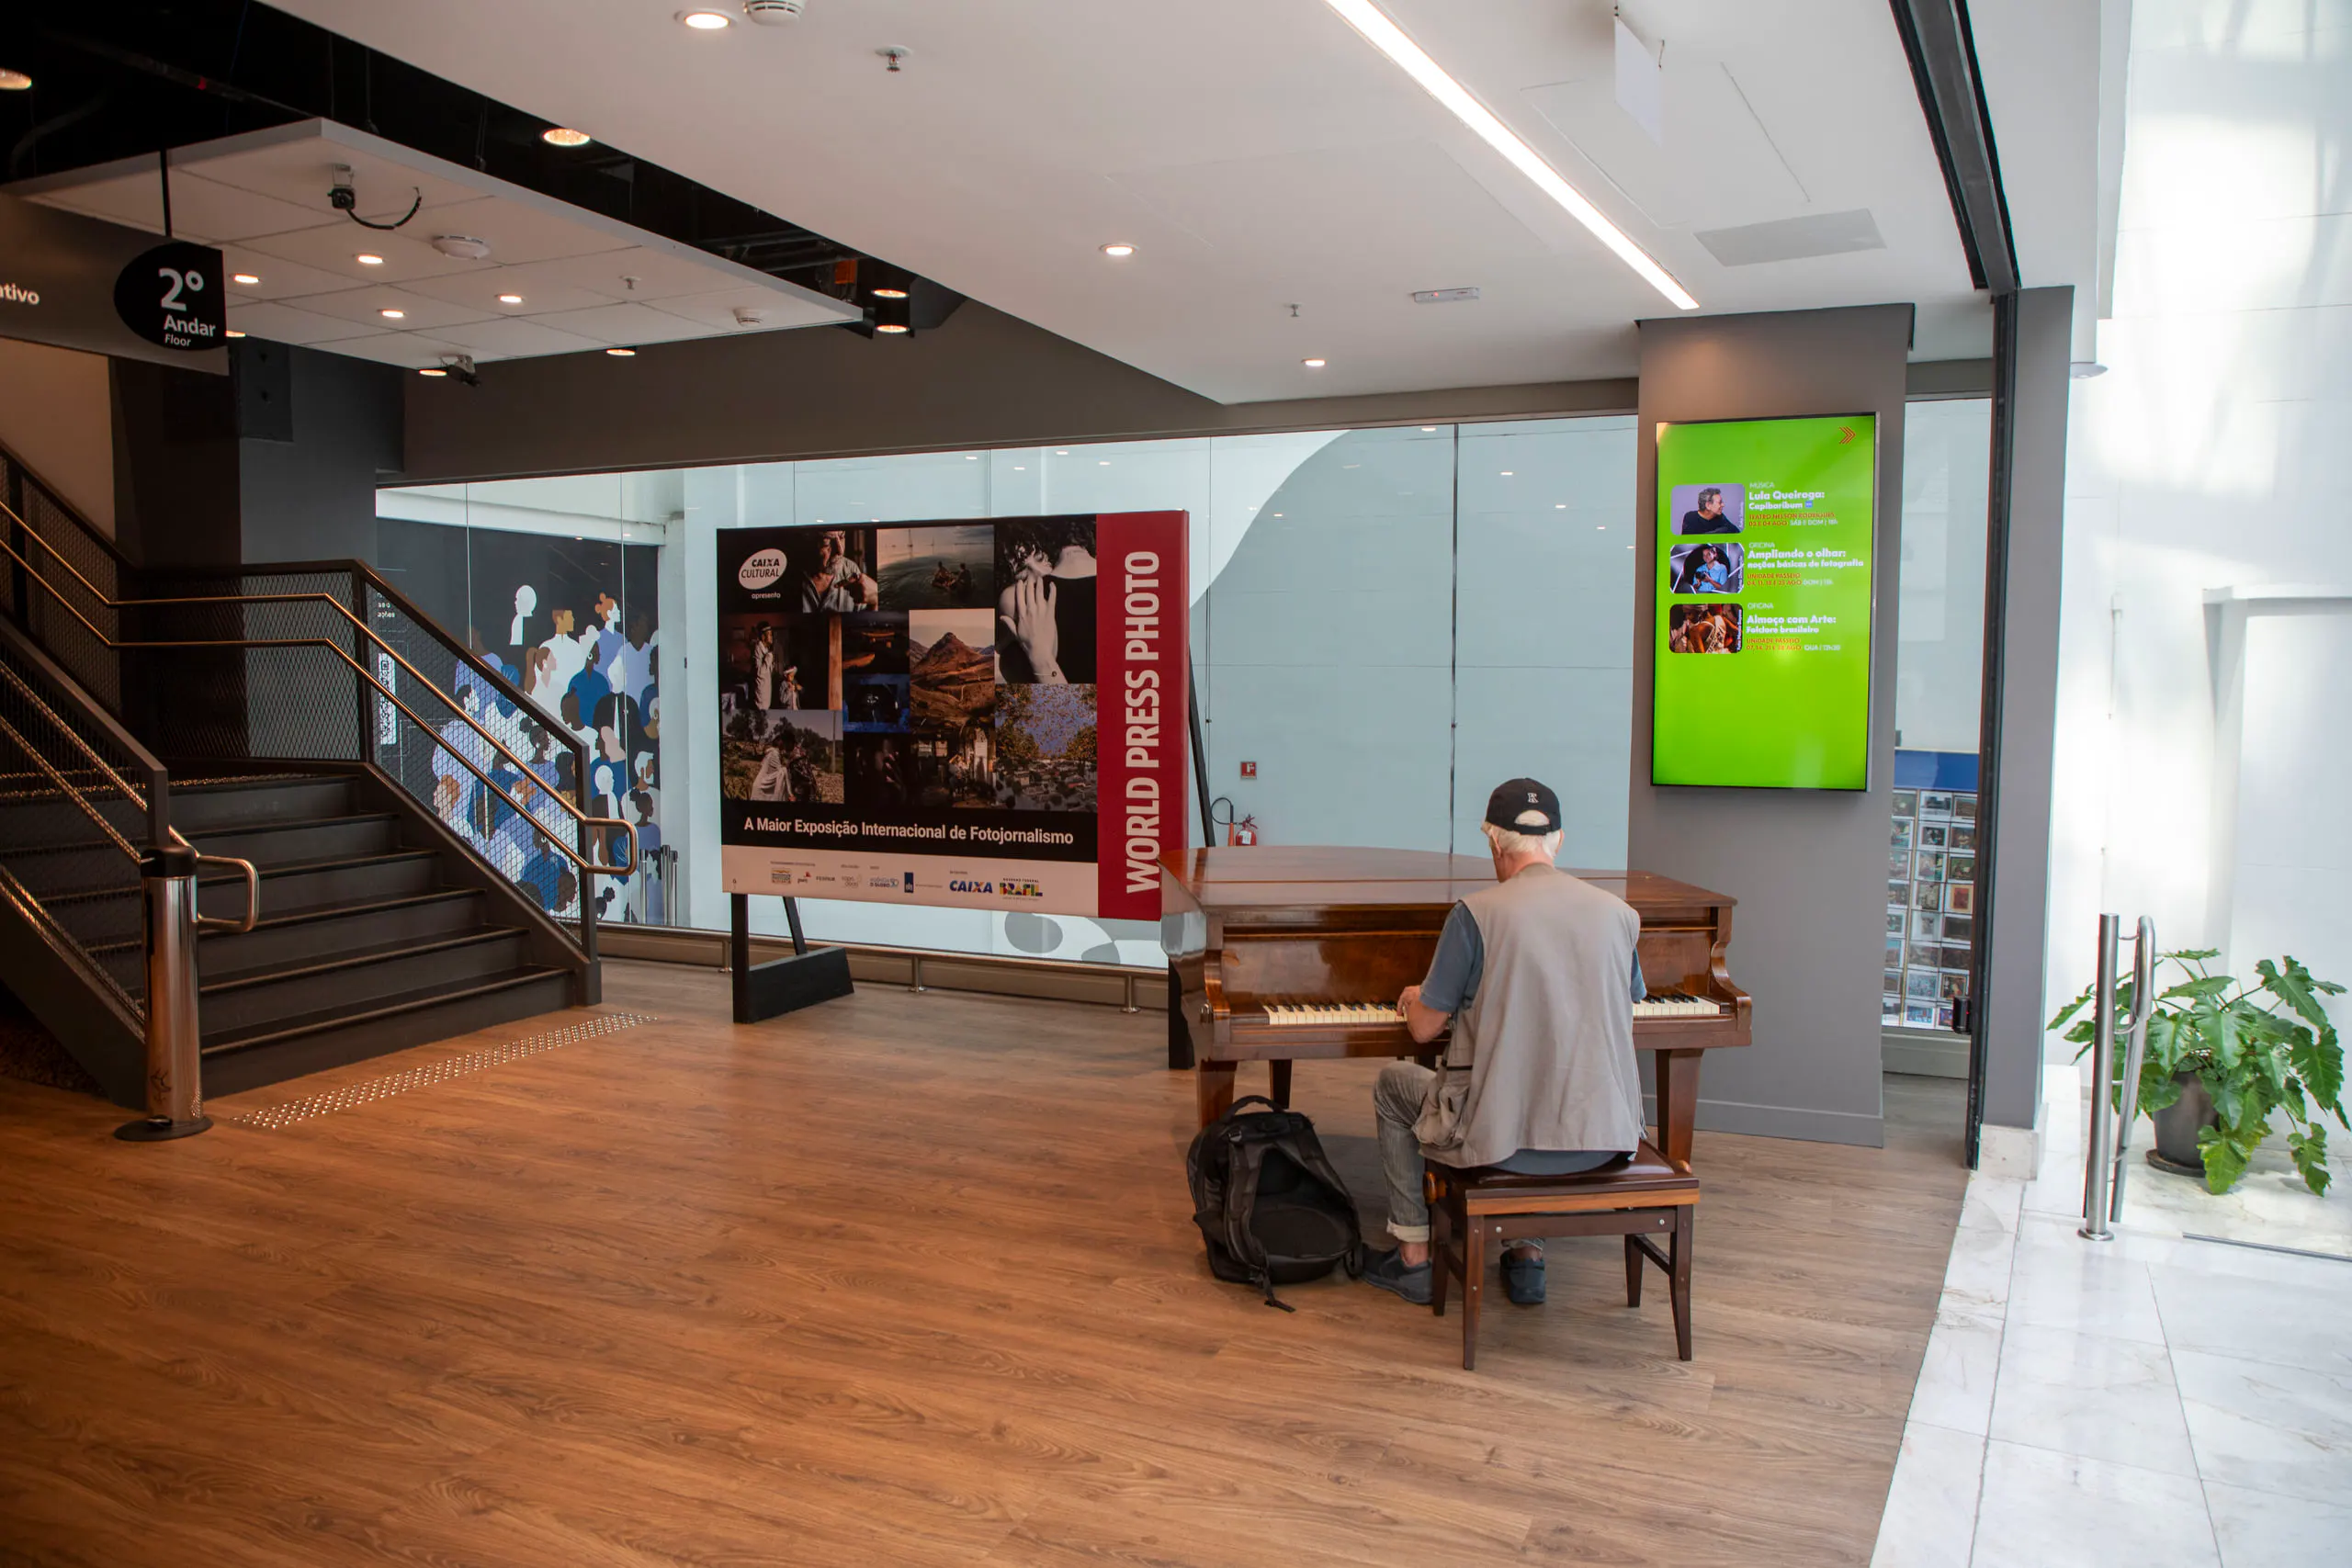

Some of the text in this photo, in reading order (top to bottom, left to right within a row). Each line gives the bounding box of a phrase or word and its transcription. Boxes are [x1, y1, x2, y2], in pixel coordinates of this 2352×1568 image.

[164, 314, 216, 337] Andar
[164, 334, 191, 347] Floor
[1748, 491, 1826, 501] Lula Queiroga:
[1747, 548, 1804, 560] Ampliando
[1815, 547, 1846, 558] olhar:
[752, 558, 780, 567] CAIXA
[1747, 561, 1775, 570] noções
[1820, 558, 1864, 569] fotografia
[741, 569, 780, 579] CULTURAL
[1747, 615, 1784, 626] Almoço
[1810, 615, 1837, 624] Arte:
[1125, 551, 1160, 894] WORLD PRESS PHOTO
[744, 817, 1074, 844] A Maior Exposição Internacional de Fotojornalismo
[949, 880, 993, 894] CAIXA
[999, 882, 1043, 897] BRASIL
